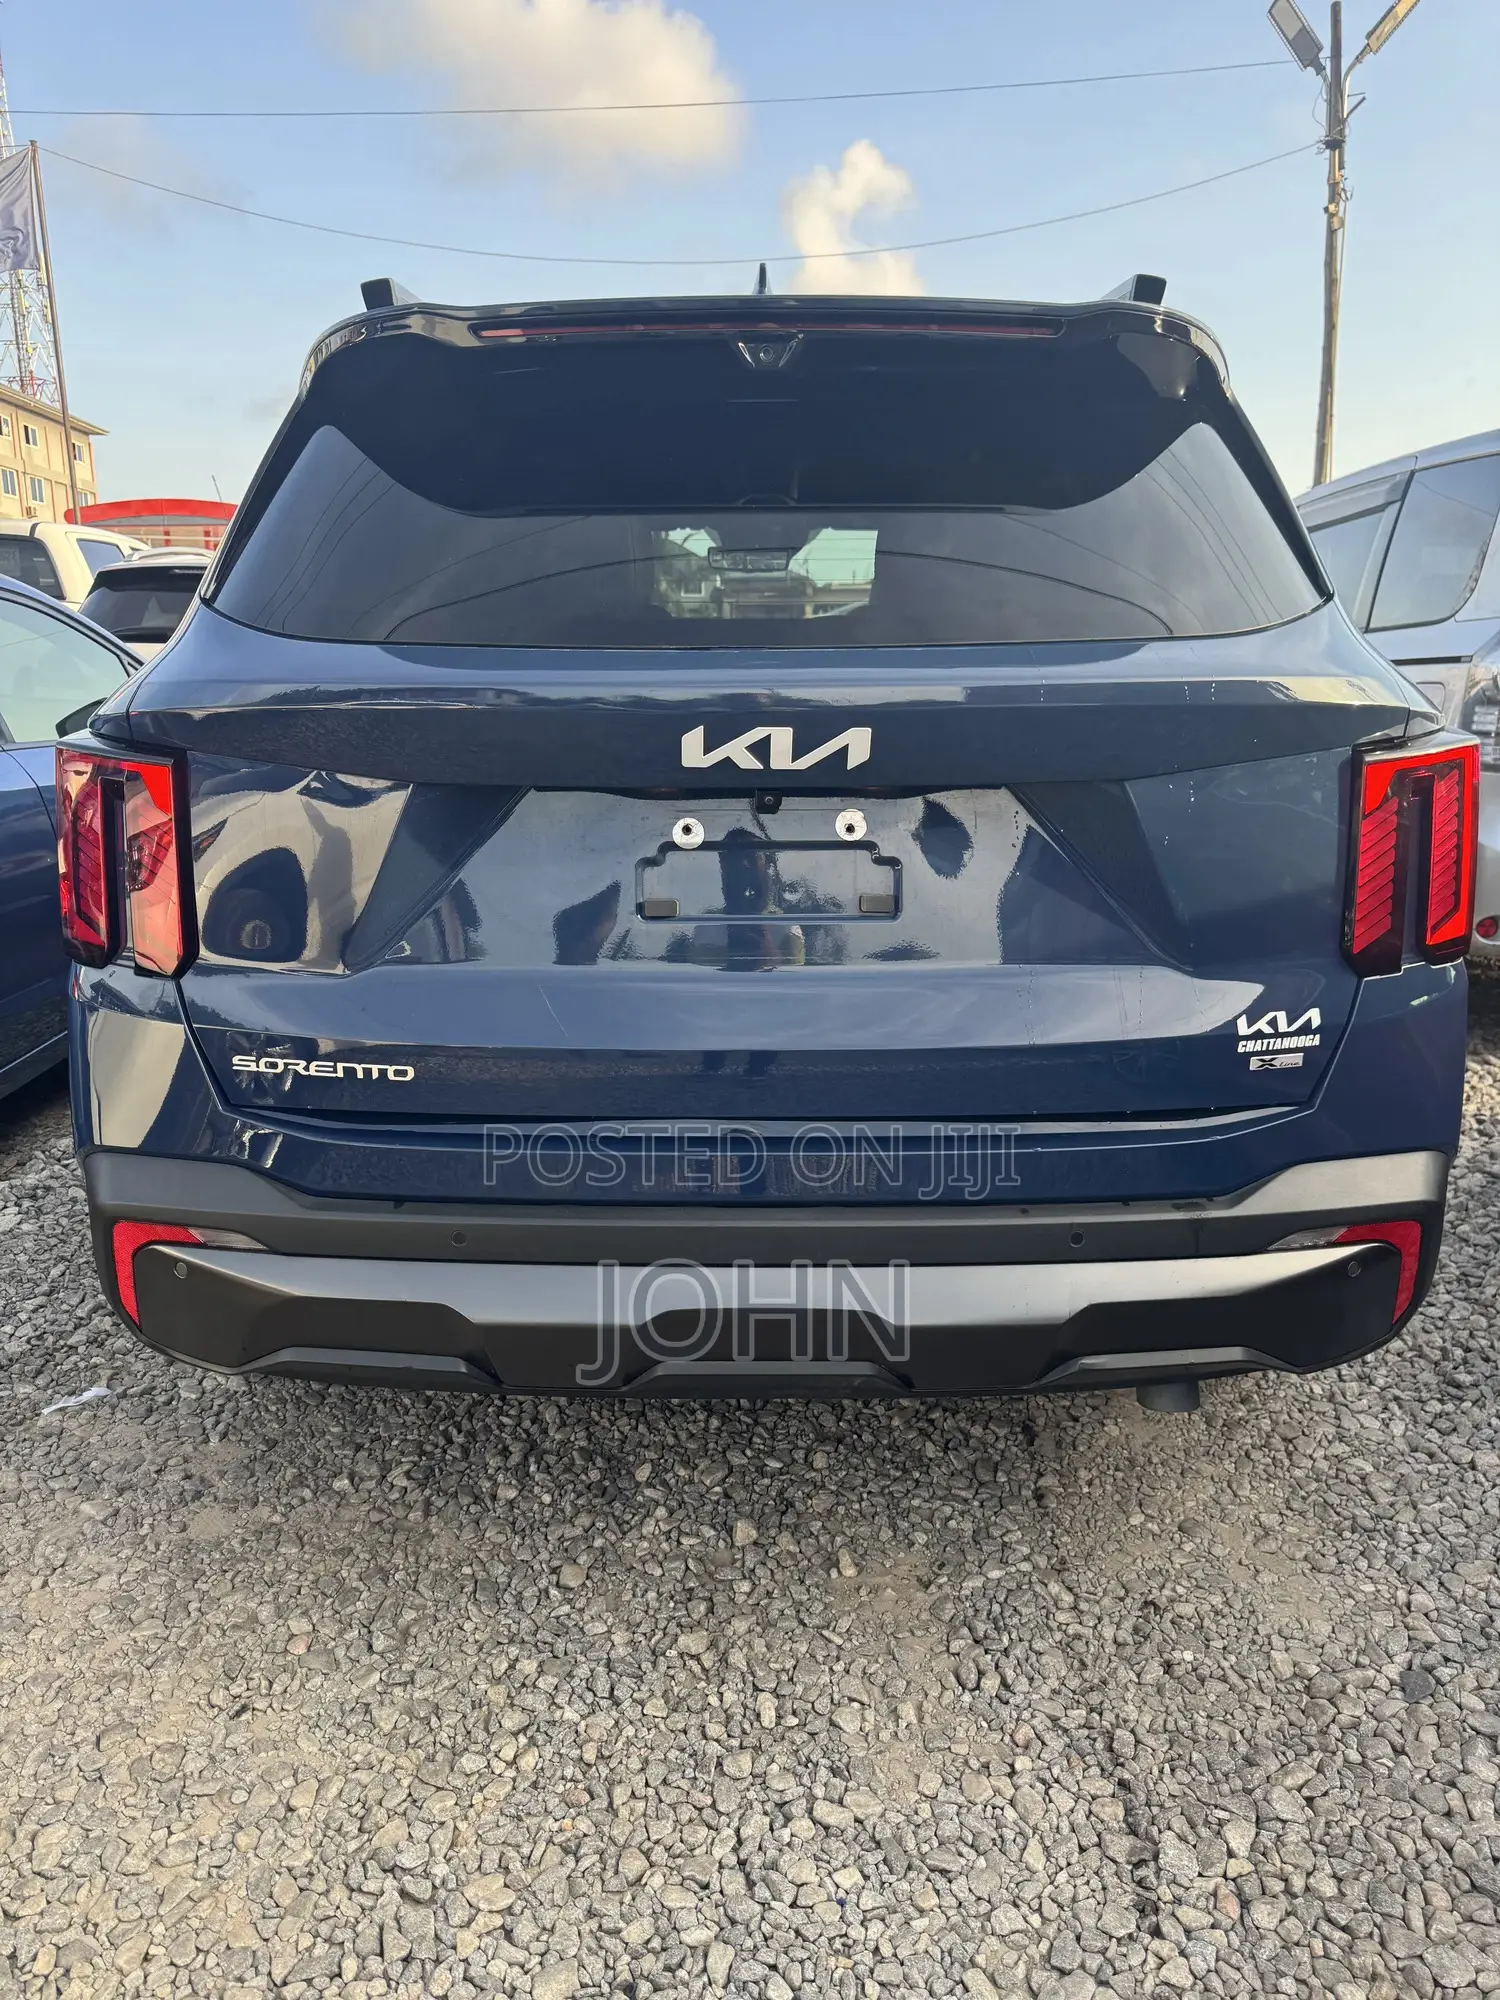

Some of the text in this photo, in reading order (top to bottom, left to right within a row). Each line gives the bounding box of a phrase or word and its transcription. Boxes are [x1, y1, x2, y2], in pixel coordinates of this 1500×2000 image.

[682, 725, 872, 770] KIA
[1237, 1007, 1321, 1036] KIA
[1237, 1034, 1321, 1053] CHATTANOOGA
[232, 1054, 415, 1082] SORENTO
